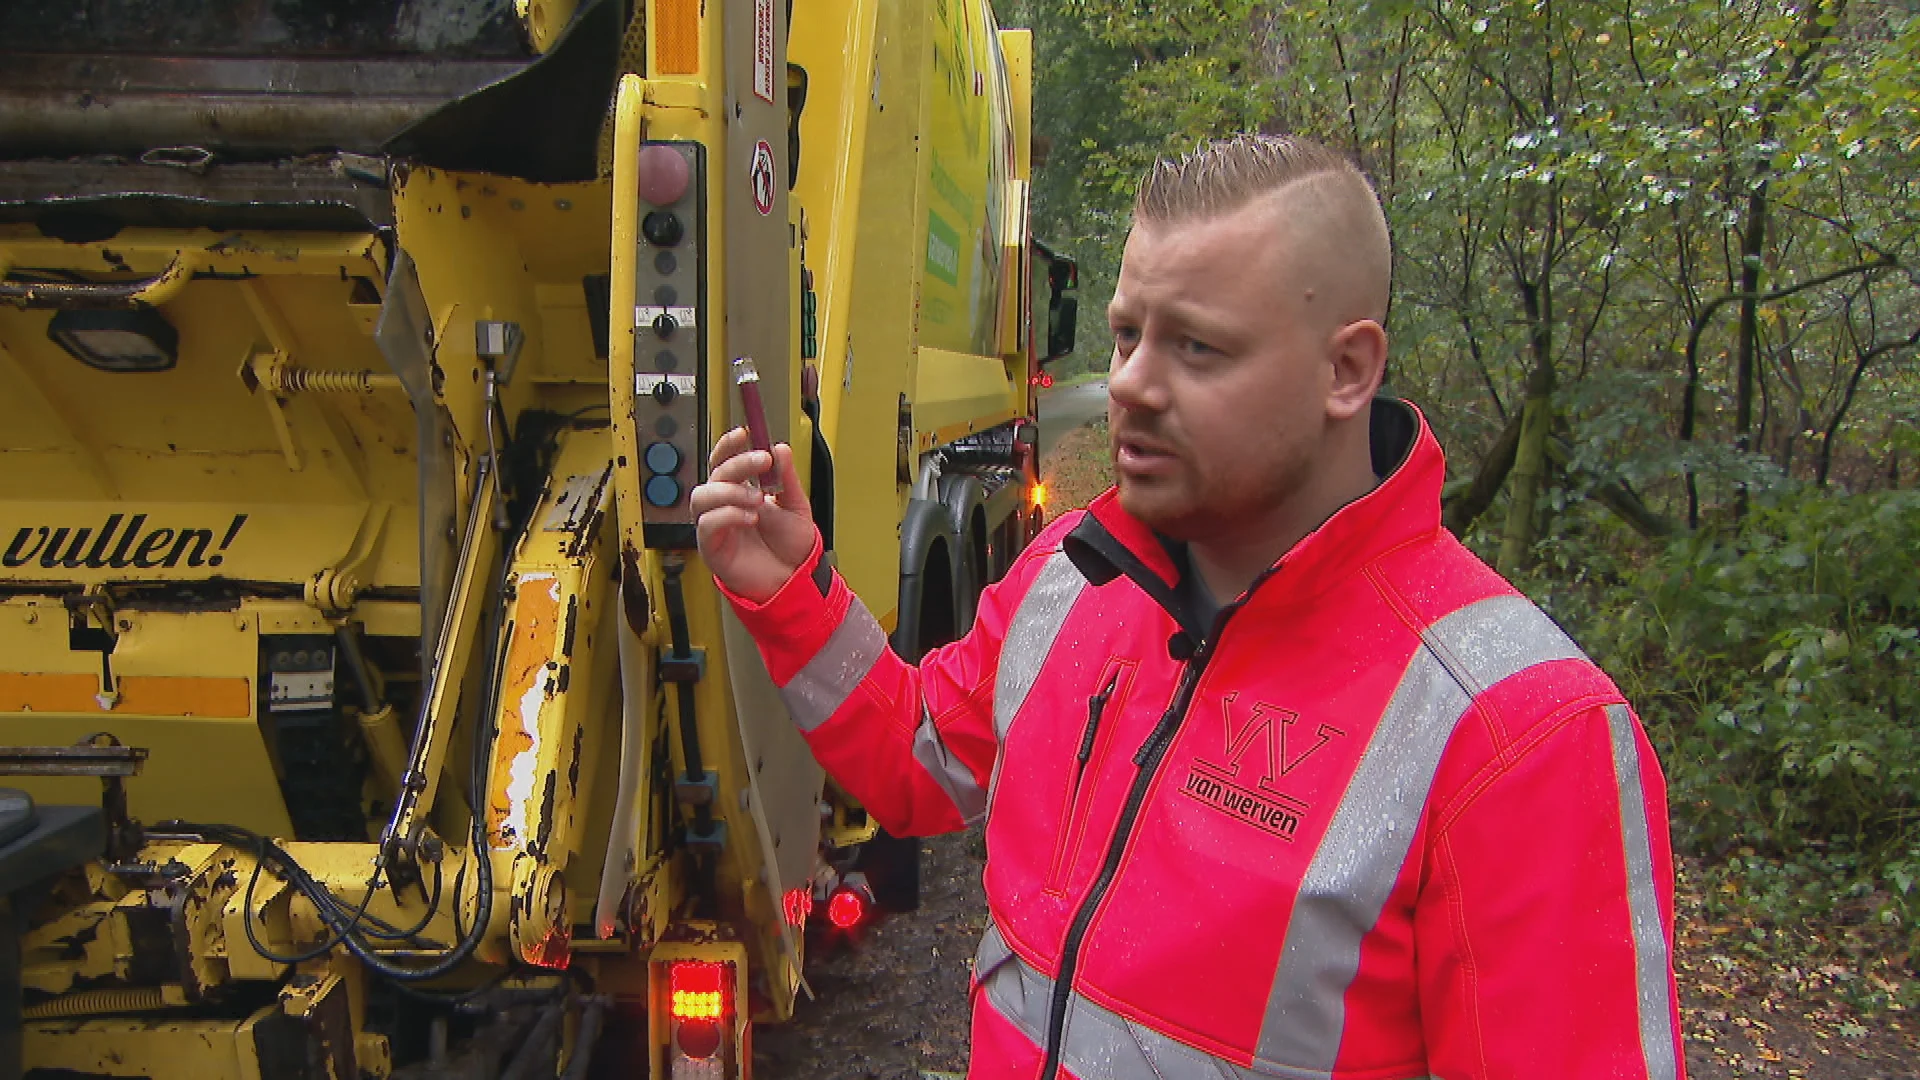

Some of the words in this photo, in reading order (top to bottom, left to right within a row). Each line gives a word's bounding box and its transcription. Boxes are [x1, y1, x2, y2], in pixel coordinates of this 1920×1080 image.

[2, 513, 249, 569] vullen!
[1186, 772, 1222, 802] van
[1223, 788, 1299, 835] werven
